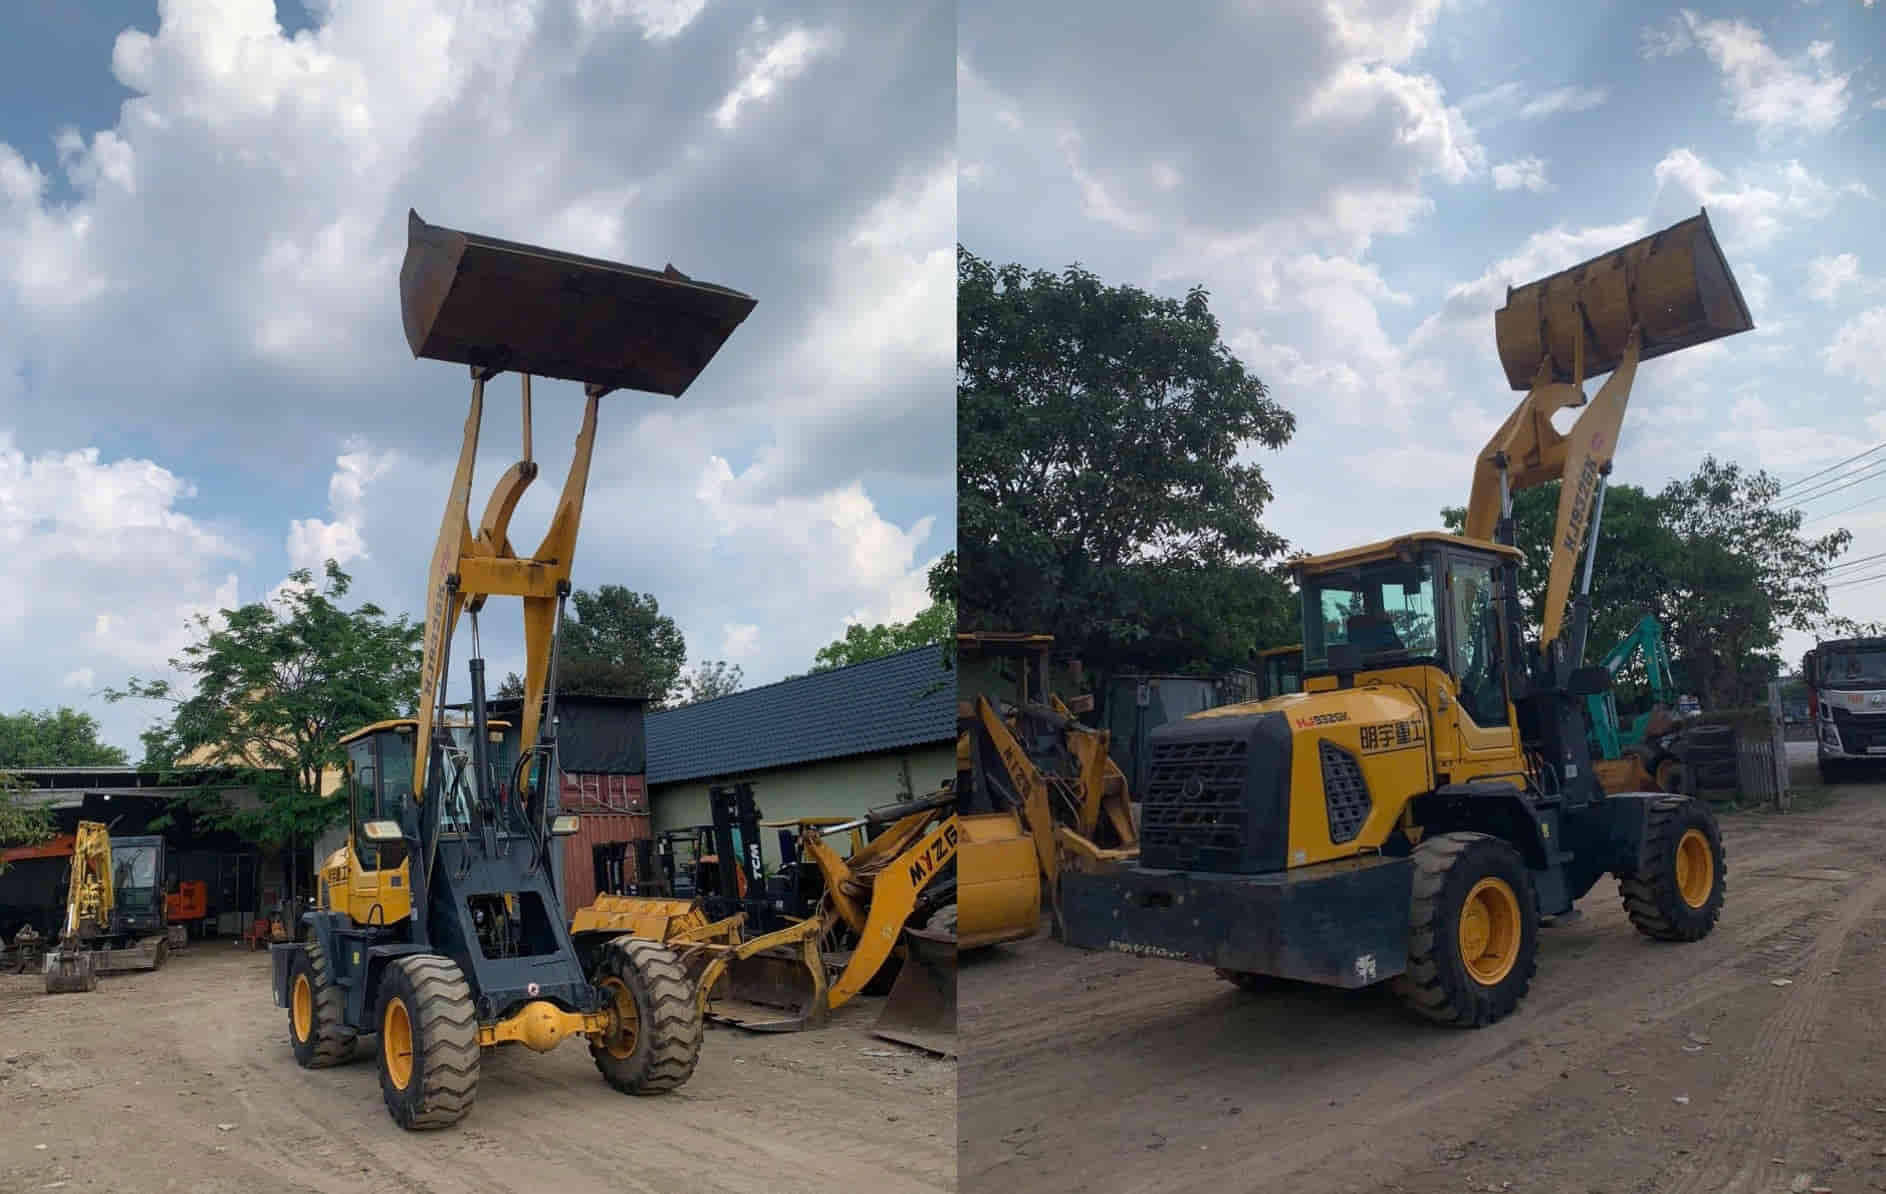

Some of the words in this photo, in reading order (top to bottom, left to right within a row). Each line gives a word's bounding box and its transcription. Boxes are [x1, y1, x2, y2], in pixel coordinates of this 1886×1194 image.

[1360, 719, 1425, 749] 明宇重工
[749, 843, 762, 881] TCM
